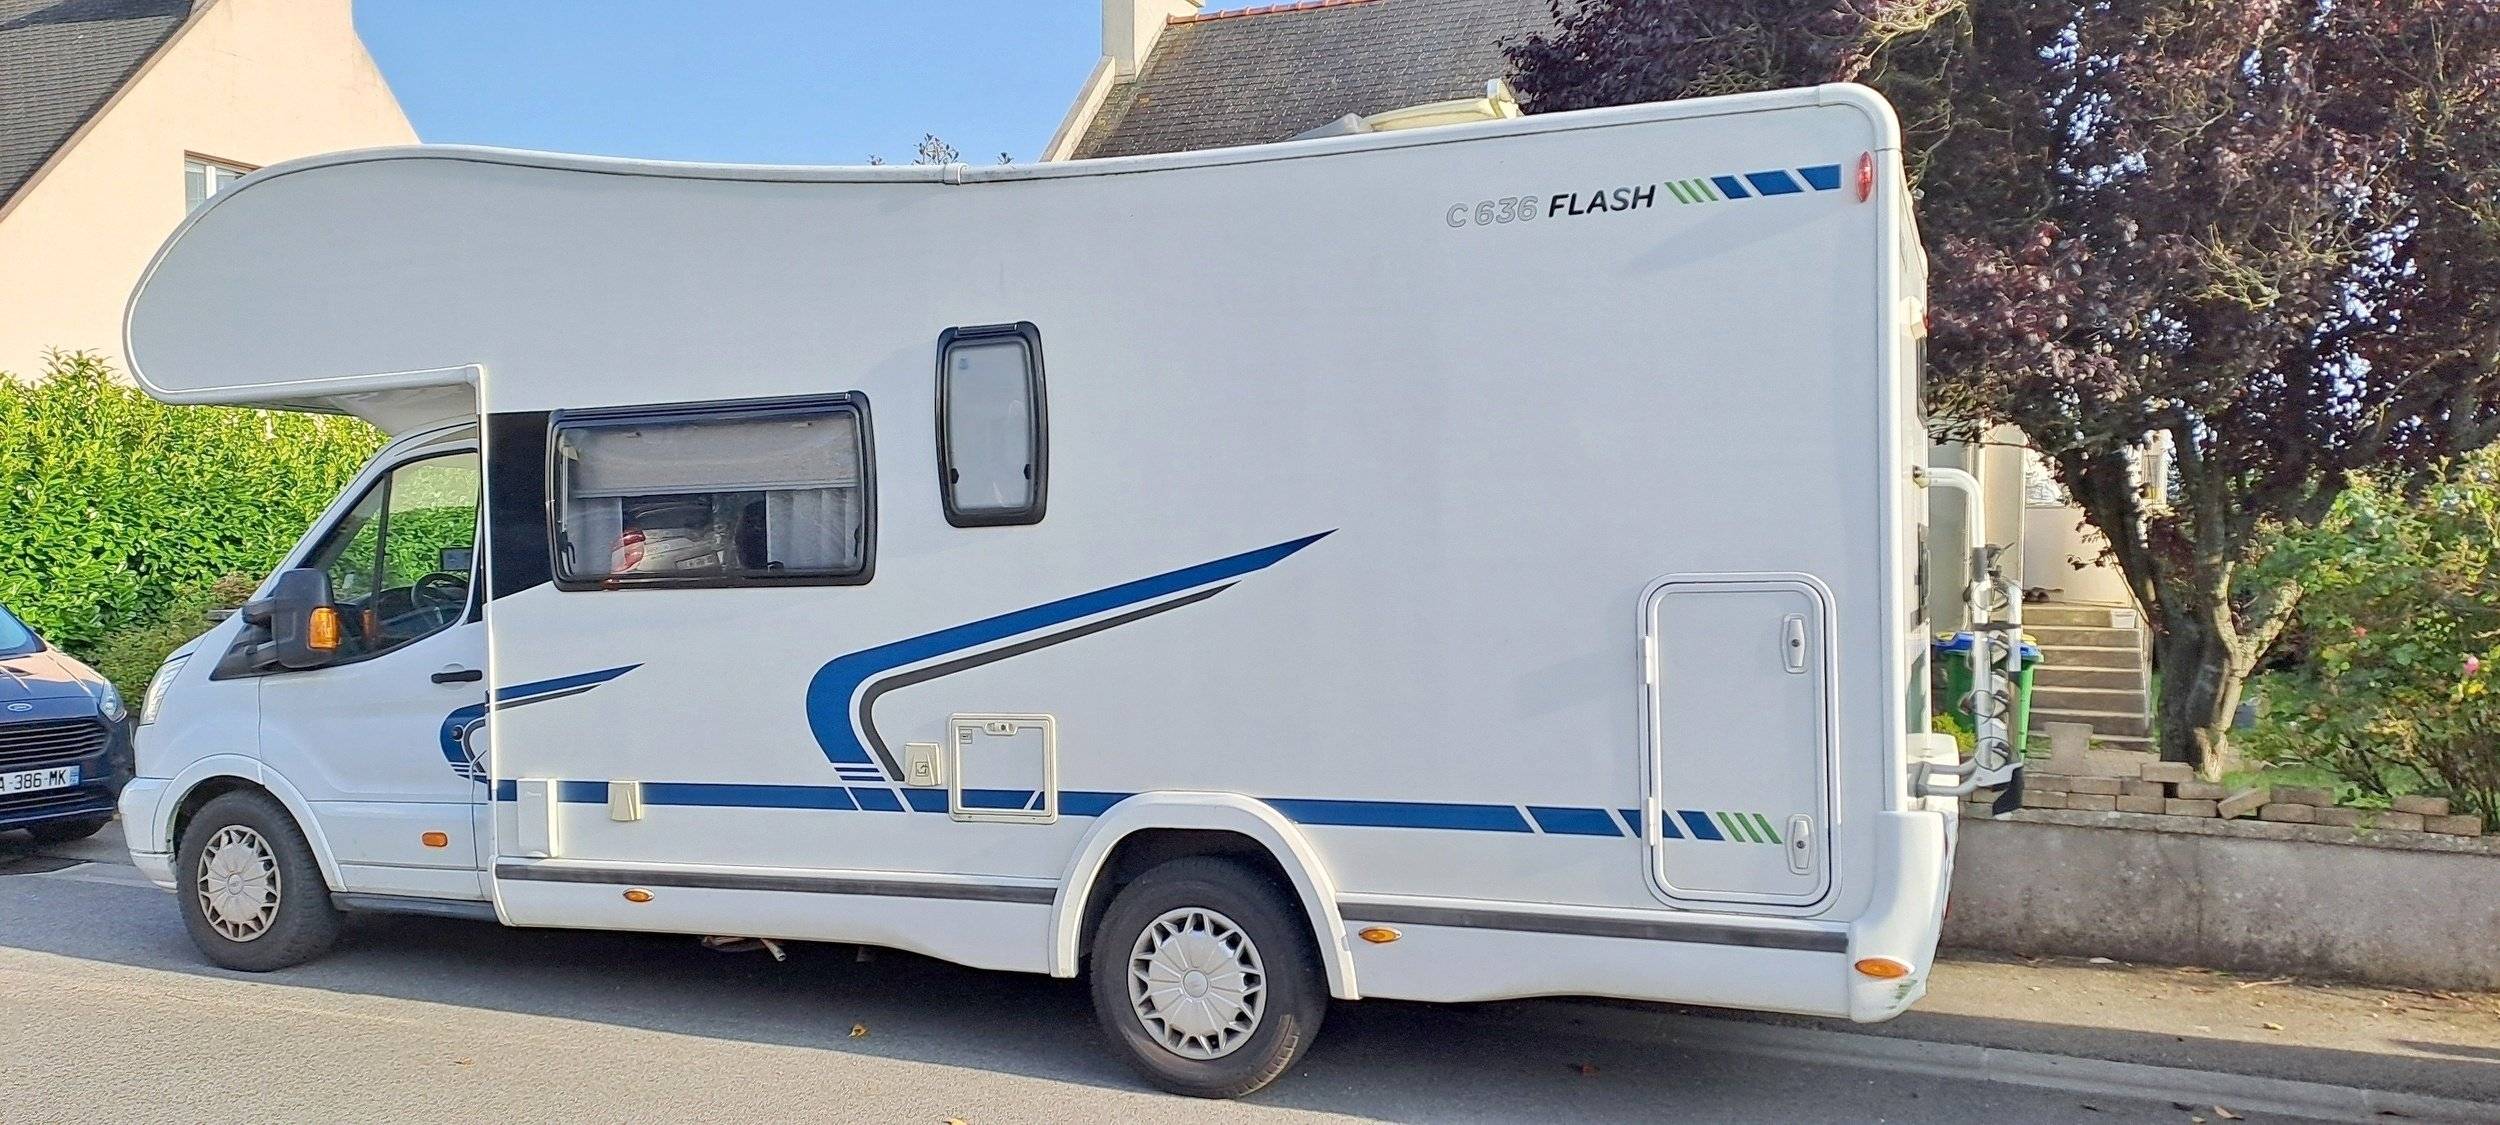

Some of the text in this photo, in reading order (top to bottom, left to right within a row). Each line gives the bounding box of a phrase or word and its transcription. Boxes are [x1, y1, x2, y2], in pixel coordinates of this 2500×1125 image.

[1446, 184, 1656, 227] C 636 FLASH
